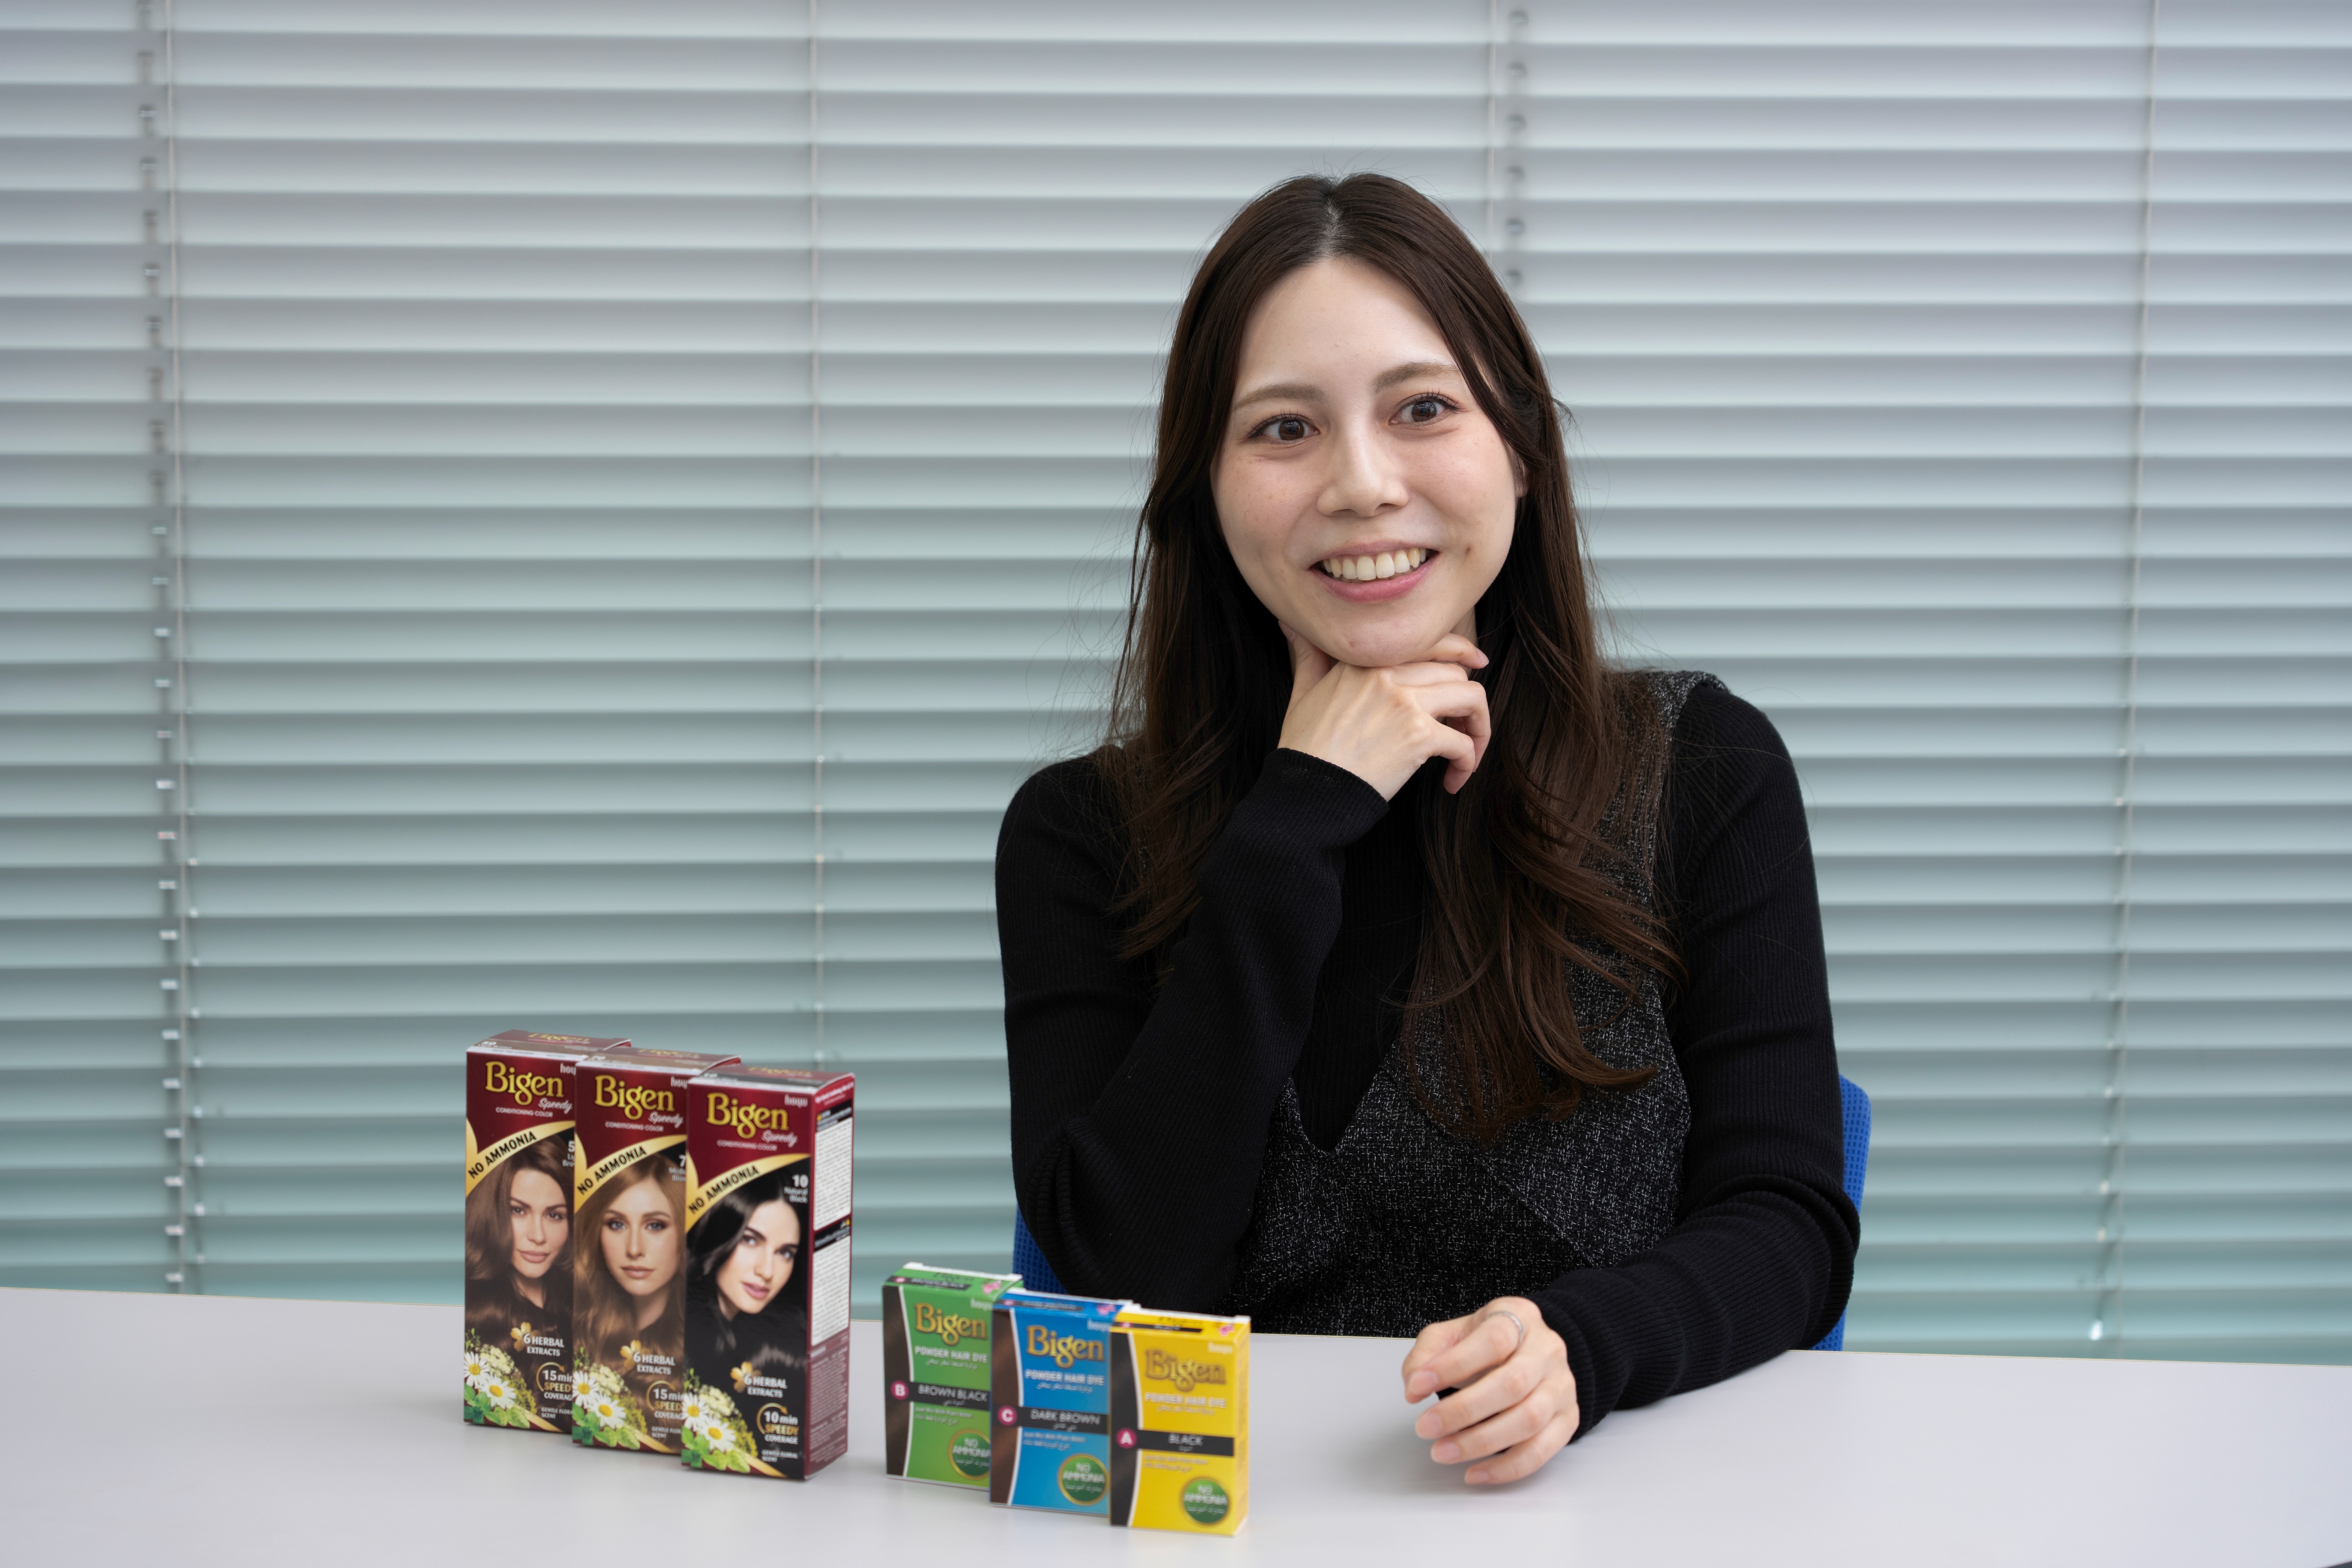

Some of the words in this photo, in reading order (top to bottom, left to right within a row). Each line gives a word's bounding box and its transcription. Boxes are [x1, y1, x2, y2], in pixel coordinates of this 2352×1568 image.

[560, 1062, 576, 1075] hoy
[485, 1061, 564, 1106] Bigen
[671, 1076, 688, 1090] hoy
[595, 1075, 675, 1120] Bigen
[785, 1094, 808, 1108] hoyu
[495, 1107, 534, 1117] CONDITIONING
[534, 1109, 553, 1118] COLOR
[538, 1098, 572, 1114] Speedy
[648, 1111, 684, 1129] Speedy
[707, 1092, 789, 1139] Bigen
[605, 1121, 644, 1131] CONDITIONING
[645, 1124, 664, 1132] COLOR
[717, 1139, 757, 1150] CONDITIONING
[758, 1143, 778, 1151] COLOR
[761, 1130, 798, 1148] Speedy
[568, 1140, 575, 1153] 5
[469, 1162, 484, 1179] NO
[485, 1131, 537, 1166] AMMONIA
[679, 1154, 686, 1167] 7
[577, 1178, 593, 1195] NO
[594, 1146, 647, 1182] AMMONIA
[668, 1167, 686, 1175] Medi
[792, 1174, 809, 1188] 10
[688, 1198, 704, 1215] NO
[705, 1165, 759, 1201] AMMONIA
[784, 1186, 808, 1195] Natural
[915, 1303, 987, 1345] Bigen
[524, 1333, 531, 1344] 6
[532, 1336, 564, 1348] HERBAL
[1026, 1325, 1104, 1369] Bigen
[527, 1346, 561, 1357] EXTRACTS
[914, 1345, 949, 1359] POWDER
[951, 1350, 971, 1361] HAIR
[972, 1353, 988, 1363] DYE
[634, 1352, 641, 1362] 6
[642, 1354, 675, 1366] HERBAL
[543, 1369, 557, 1381] 15
[637, 1365, 671, 1375] EXTRACTS
[1145, 1348, 1226, 1392] Bigen
[744, 1374, 752, 1385] 6
[754, 1376, 787, 1389] HERBAL
[1025, 1369, 1063, 1382] POWDER
[1064, 1373, 1086, 1385] HAIR
[1087, 1375, 1104, 1386] DYE
[544, 1382, 572, 1393] SPEED
[653, 1388, 667, 1400] 15
[747, 1387, 783, 1398] EXTRACTS
[895, 1384, 906, 1396] B
[918, 1384, 956, 1399] BROWN
[957, 1390, 988, 1402] BLACK
[544, 1392, 572, 1401] COVERAG
[1145, 1392, 1183, 1405] POWDER
[1185, 1396, 1207, 1407] HAIR
[1208, 1398, 1226, 1409] DYE
[654, 1401, 682, 1411] SPEED
[654, 1410, 683, 1420] COVERAG
[763, 1411, 779, 1423] 10
[780, 1414, 798, 1425] min
[1001, 1409, 1013, 1422] C
[1031, 1409, 1058, 1422] DARK
[1059, 1412, 1101, 1425] BROWN
[765, 1423, 799, 1435] SPEEDY
[764, 1434, 798, 1444] COVERAGE
[965, 1438, 978, 1448] NO
[1120, 1431, 1132, 1445] A
[1168, 1433, 1204, 1446] BLACK
[1076, 1462, 1091, 1473] NO
[1063, 1470, 1105, 1483] AMMONIA
[1197, 1484, 1213, 1496] NO
[1184, 1492, 1228, 1505] AMMONIA
